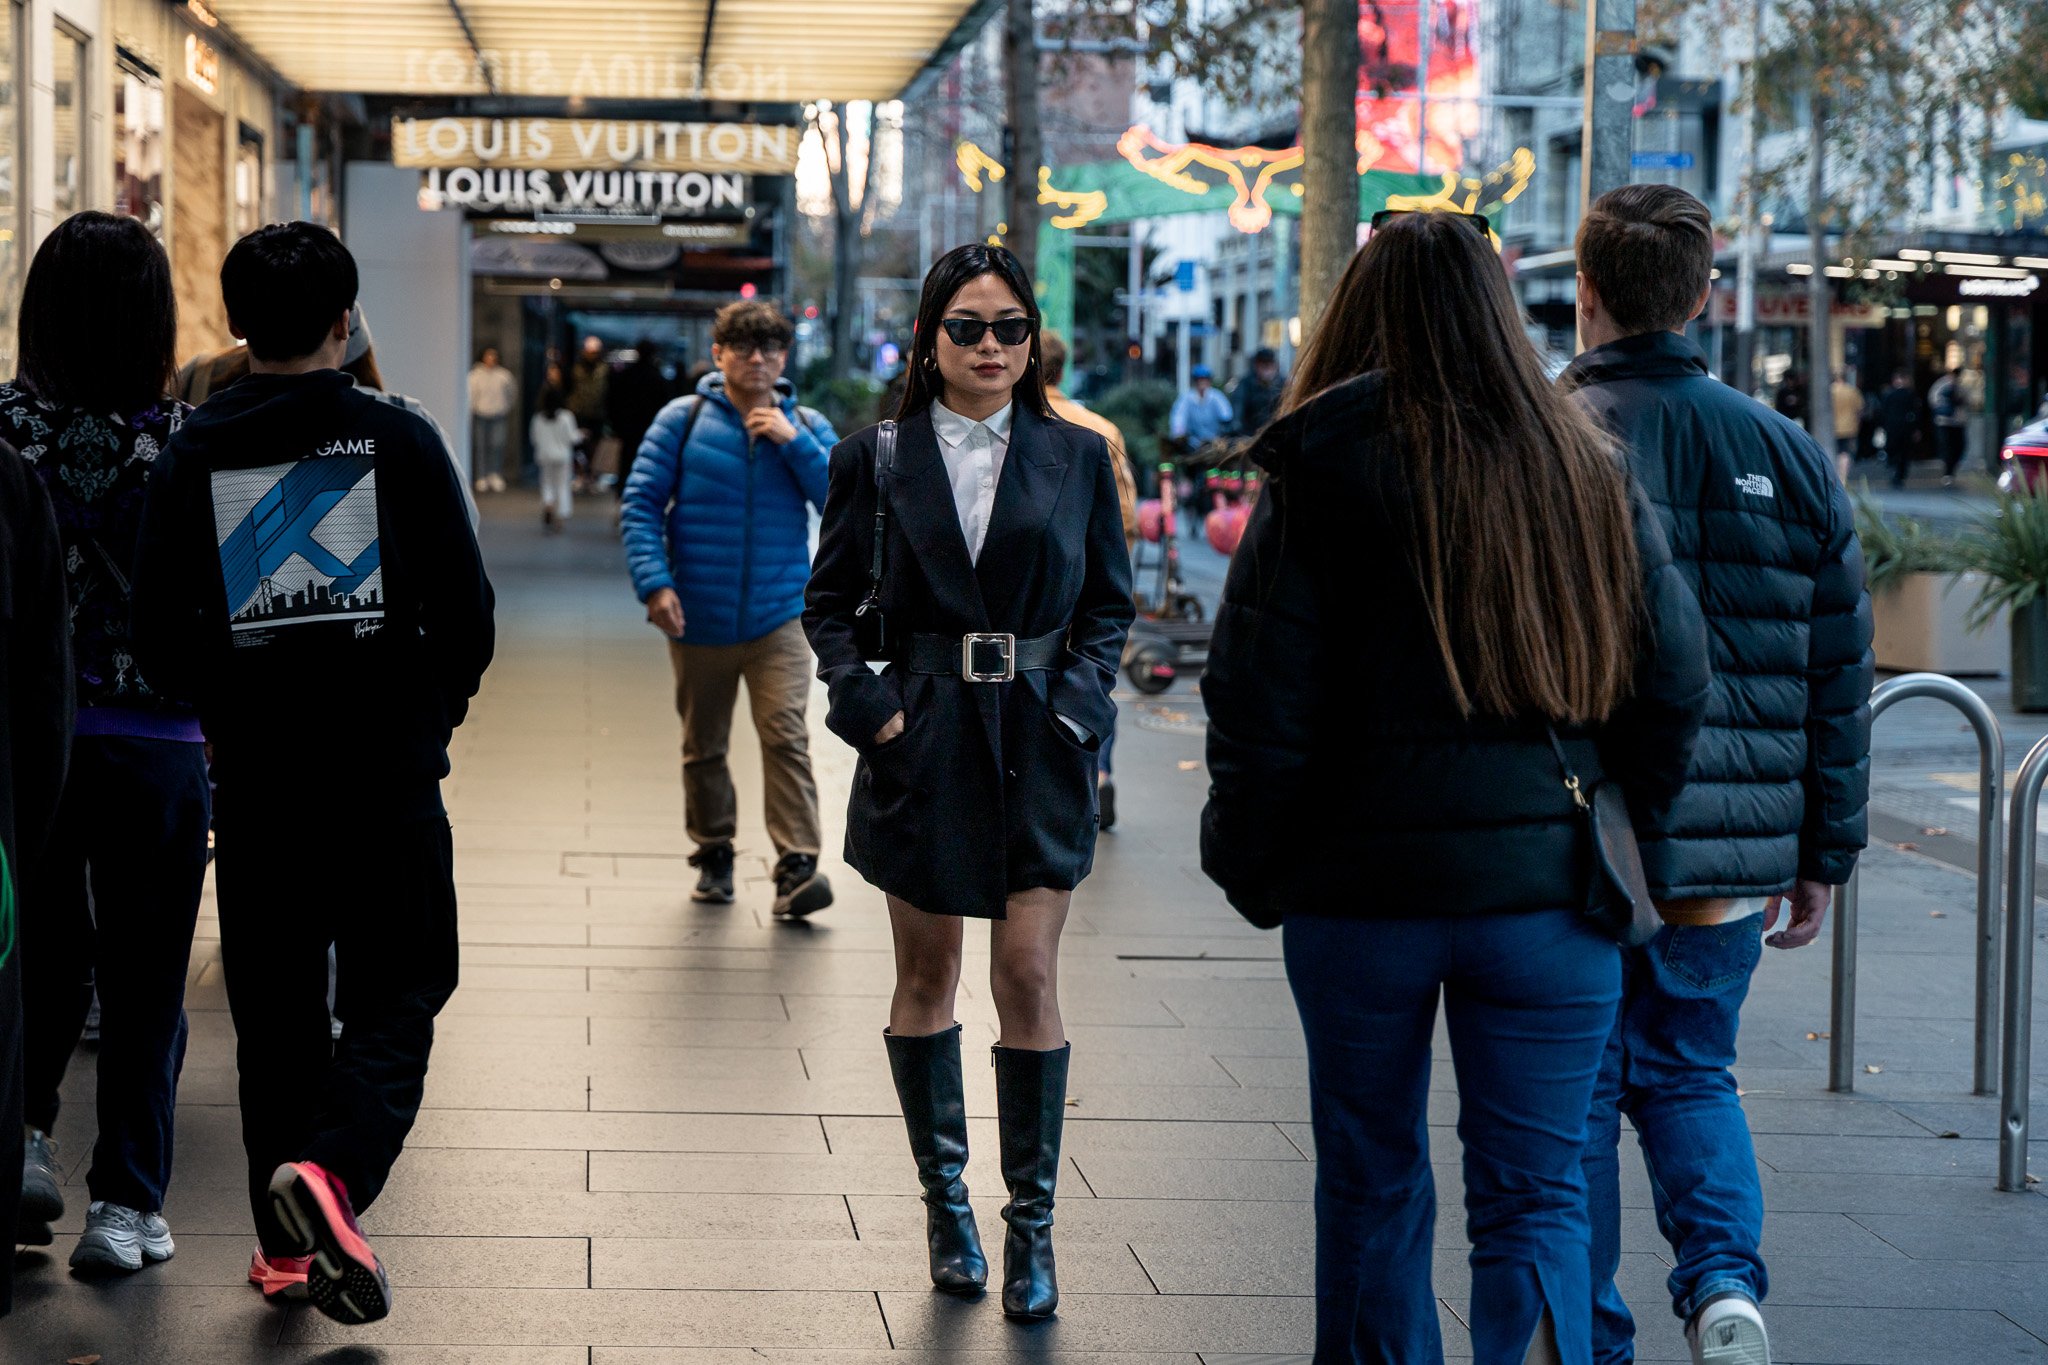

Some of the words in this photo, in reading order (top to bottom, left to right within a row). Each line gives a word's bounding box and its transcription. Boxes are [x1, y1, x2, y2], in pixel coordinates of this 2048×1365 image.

[406, 116, 552, 161] LOUIS
[570, 121, 788, 163] VUITTON
[428, 166, 550, 204] LOUIS
[562, 170, 744, 208] VUITTON
[1735, 477, 1762, 489] NORTH
[1746, 473, 1762, 483] THE
[1742, 486, 1762, 495] FACE
